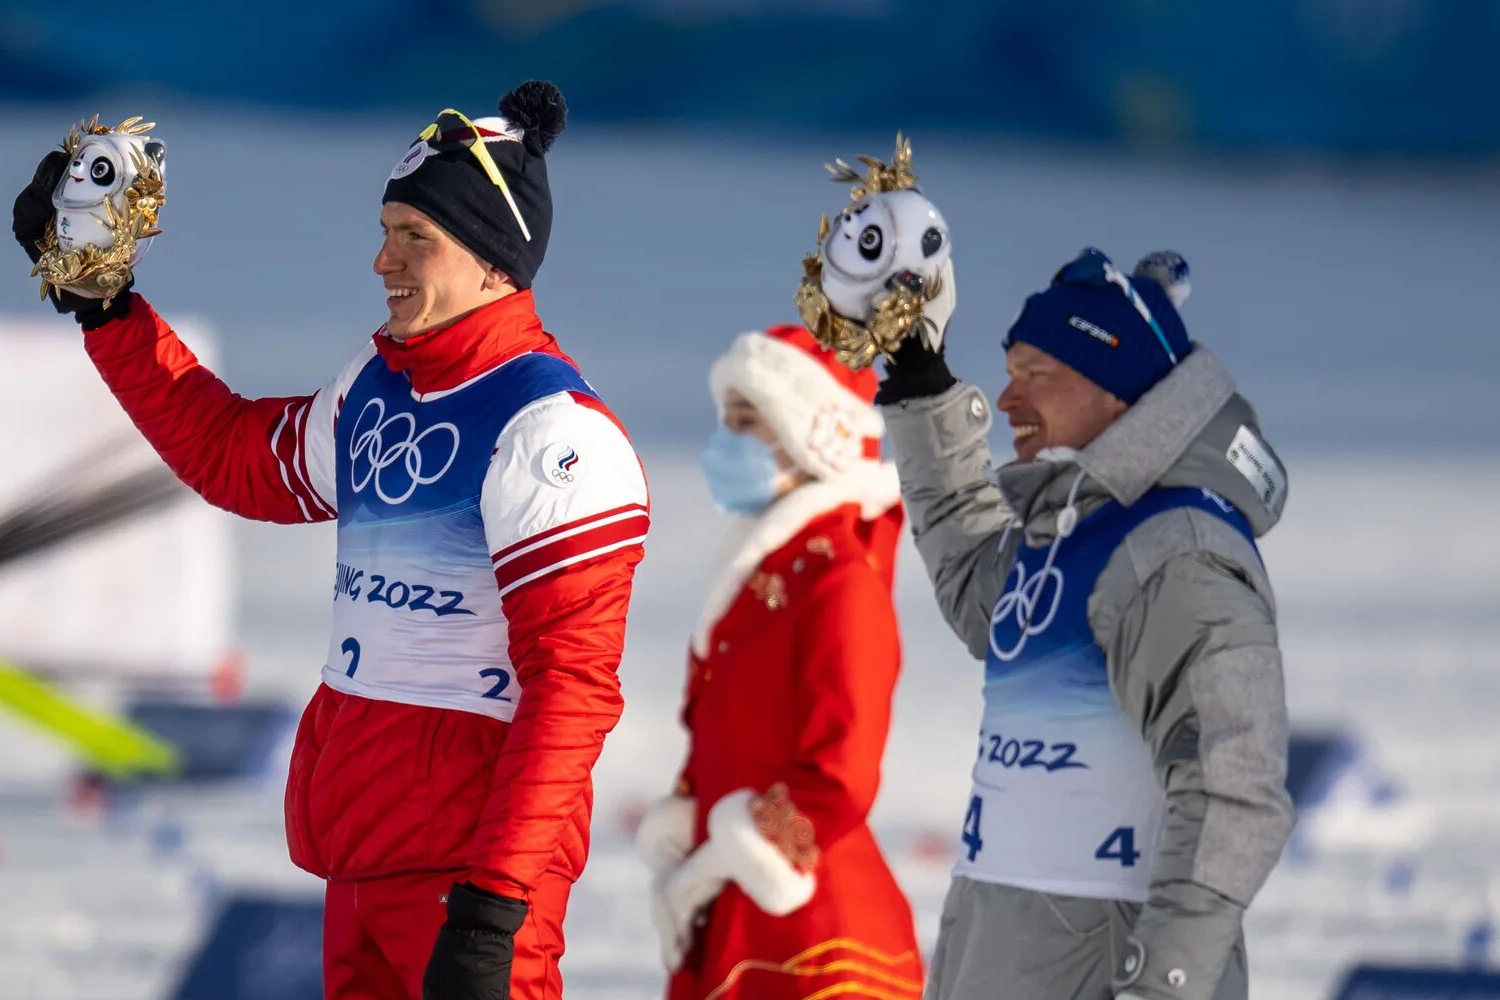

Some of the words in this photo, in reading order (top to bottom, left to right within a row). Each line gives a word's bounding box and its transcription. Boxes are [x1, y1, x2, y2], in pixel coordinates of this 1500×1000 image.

[367, 574, 478, 617] 2022
[478, 667, 512, 703] 2
[988, 734, 1090, 773] 2022
[962, 795, 983, 863] 4
[1095, 826, 1141, 868] 4
